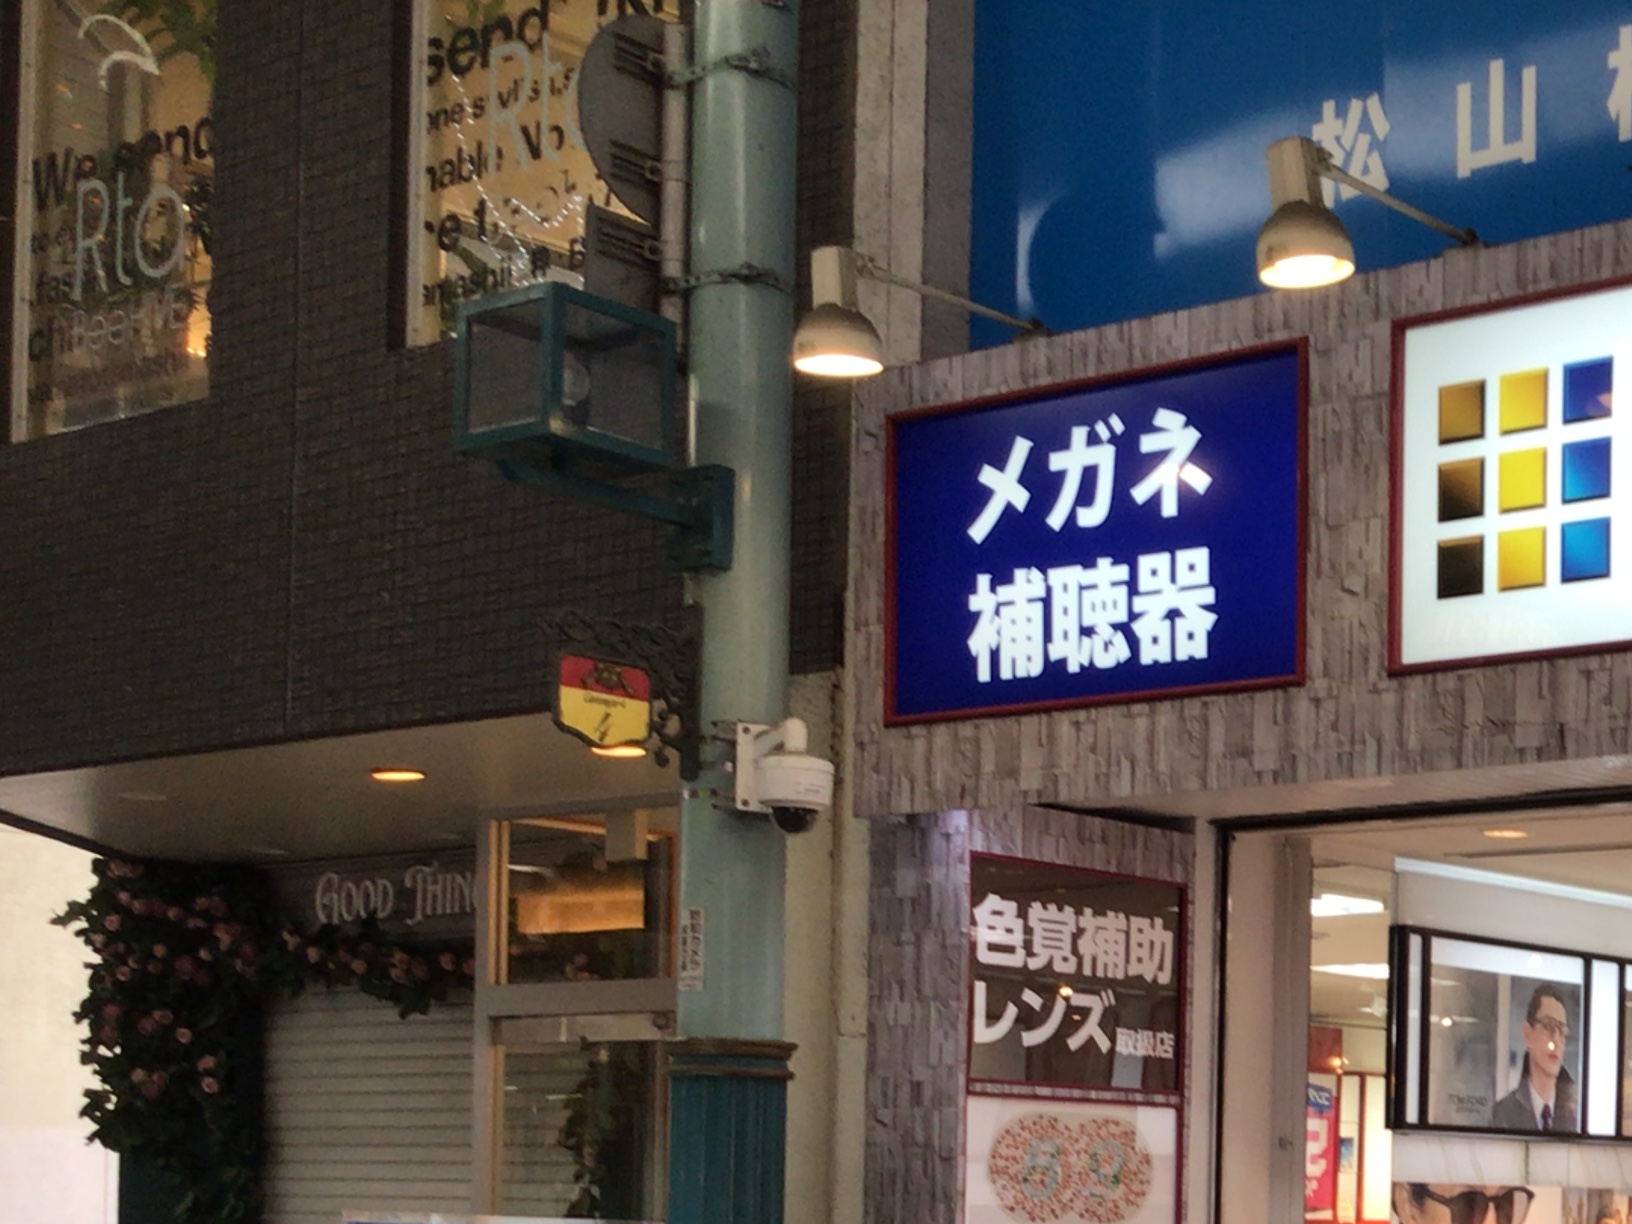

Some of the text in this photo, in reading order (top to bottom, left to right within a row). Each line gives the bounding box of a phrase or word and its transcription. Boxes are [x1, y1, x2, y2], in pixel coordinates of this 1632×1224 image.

[966, 407, 1213, 545] メガネ
[967, 546, 1218, 683] 補聴器
[314, 872, 393, 925] GOOD
[973, 892, 1174, 985] 色覚補助
[973, 980, 1116, 1055] レンズ
